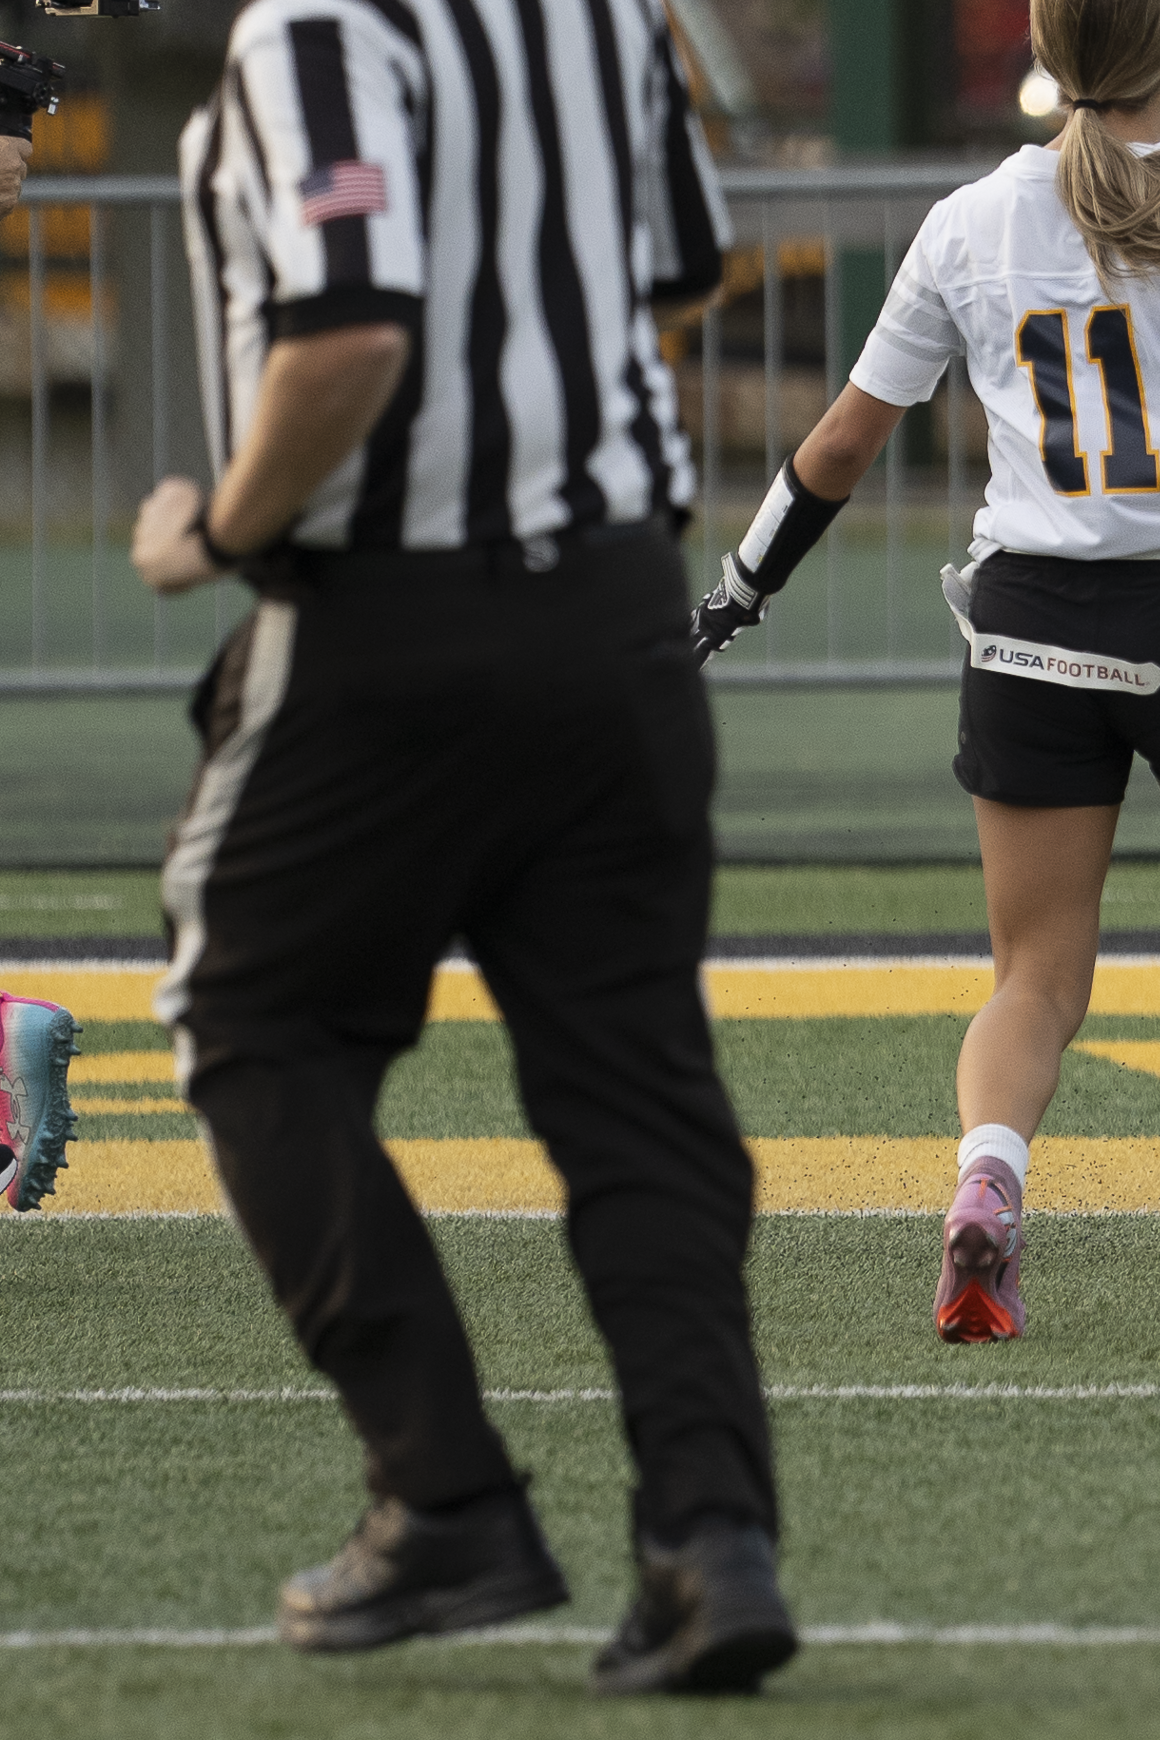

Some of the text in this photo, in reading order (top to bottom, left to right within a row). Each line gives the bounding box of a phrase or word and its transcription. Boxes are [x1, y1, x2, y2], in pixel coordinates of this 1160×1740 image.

[1015, 303, 1160, 497] 11
[1000, 648, 1146, 687] USA FOOTBALL
